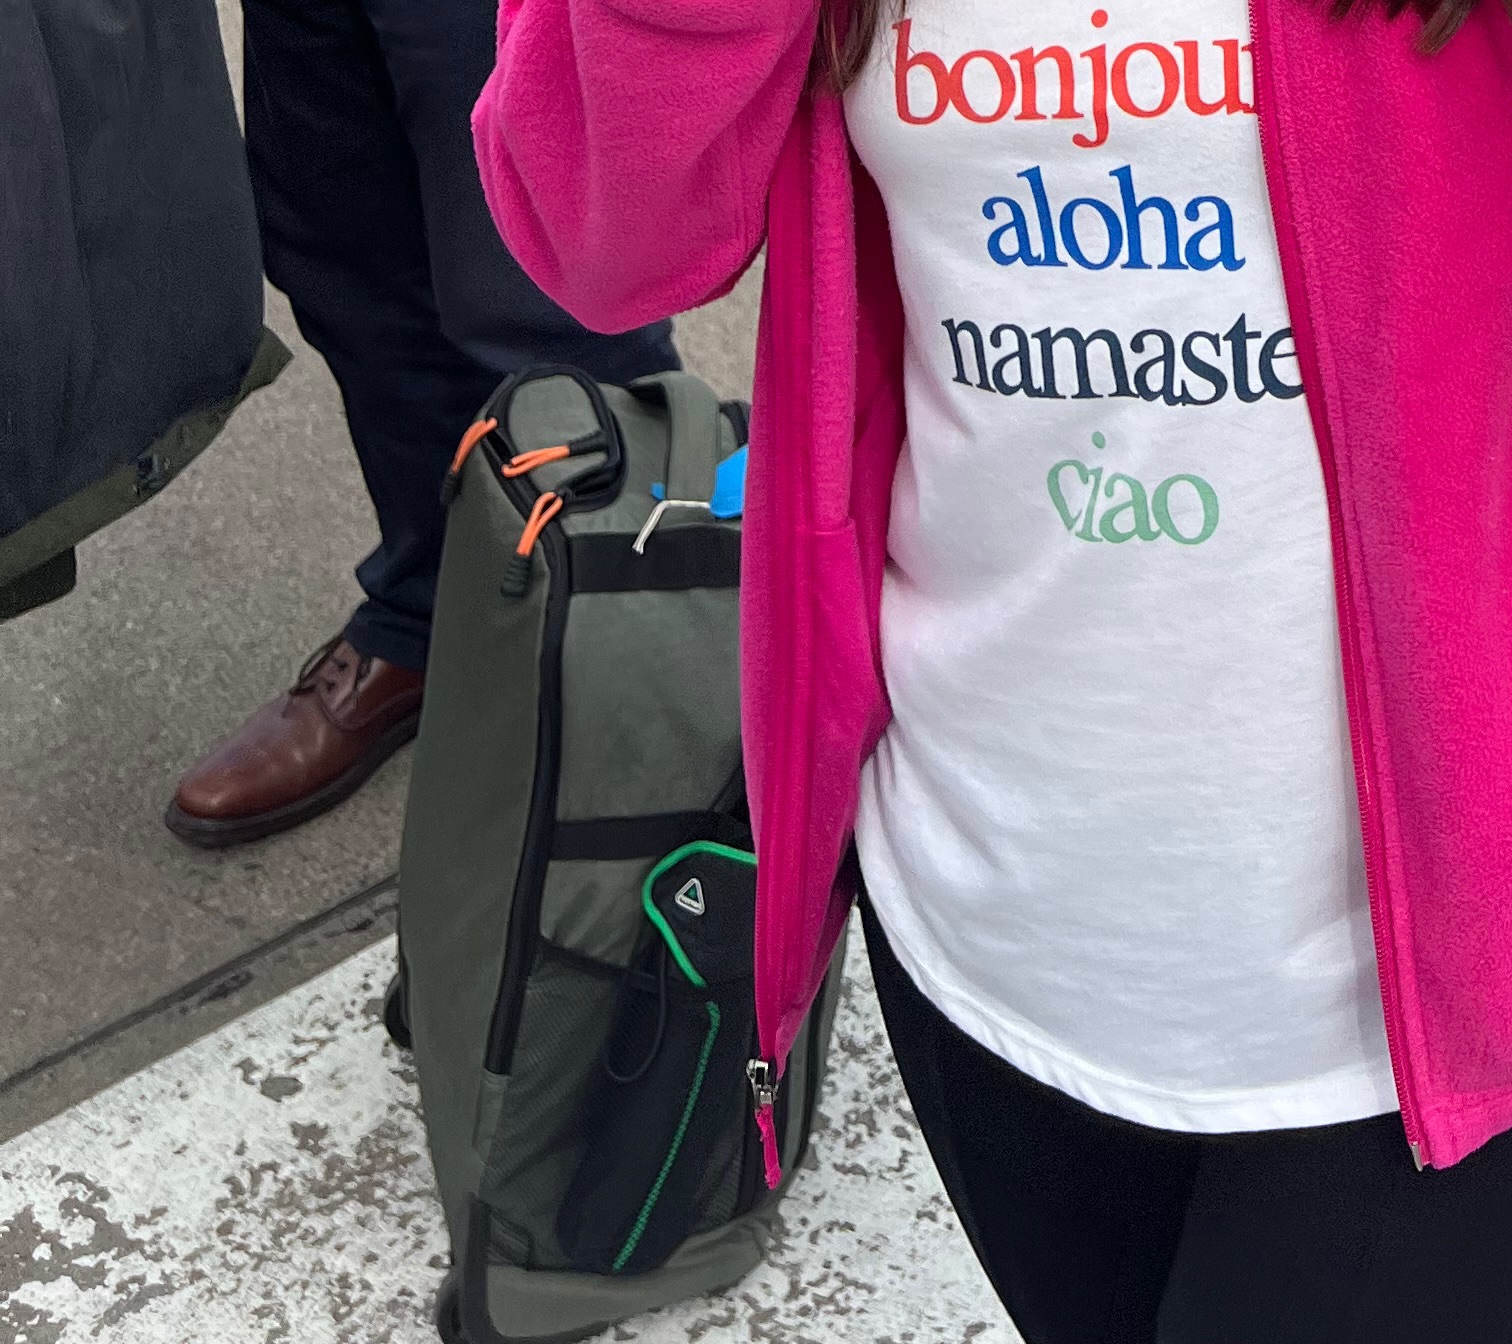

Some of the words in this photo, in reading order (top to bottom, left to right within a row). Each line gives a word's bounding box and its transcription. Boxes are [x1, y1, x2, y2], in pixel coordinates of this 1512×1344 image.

[981, 164, 1246, 272] aloha
[941, 311, 1304, 408] namaste
[1046, 431, 1221, 547] ciao
